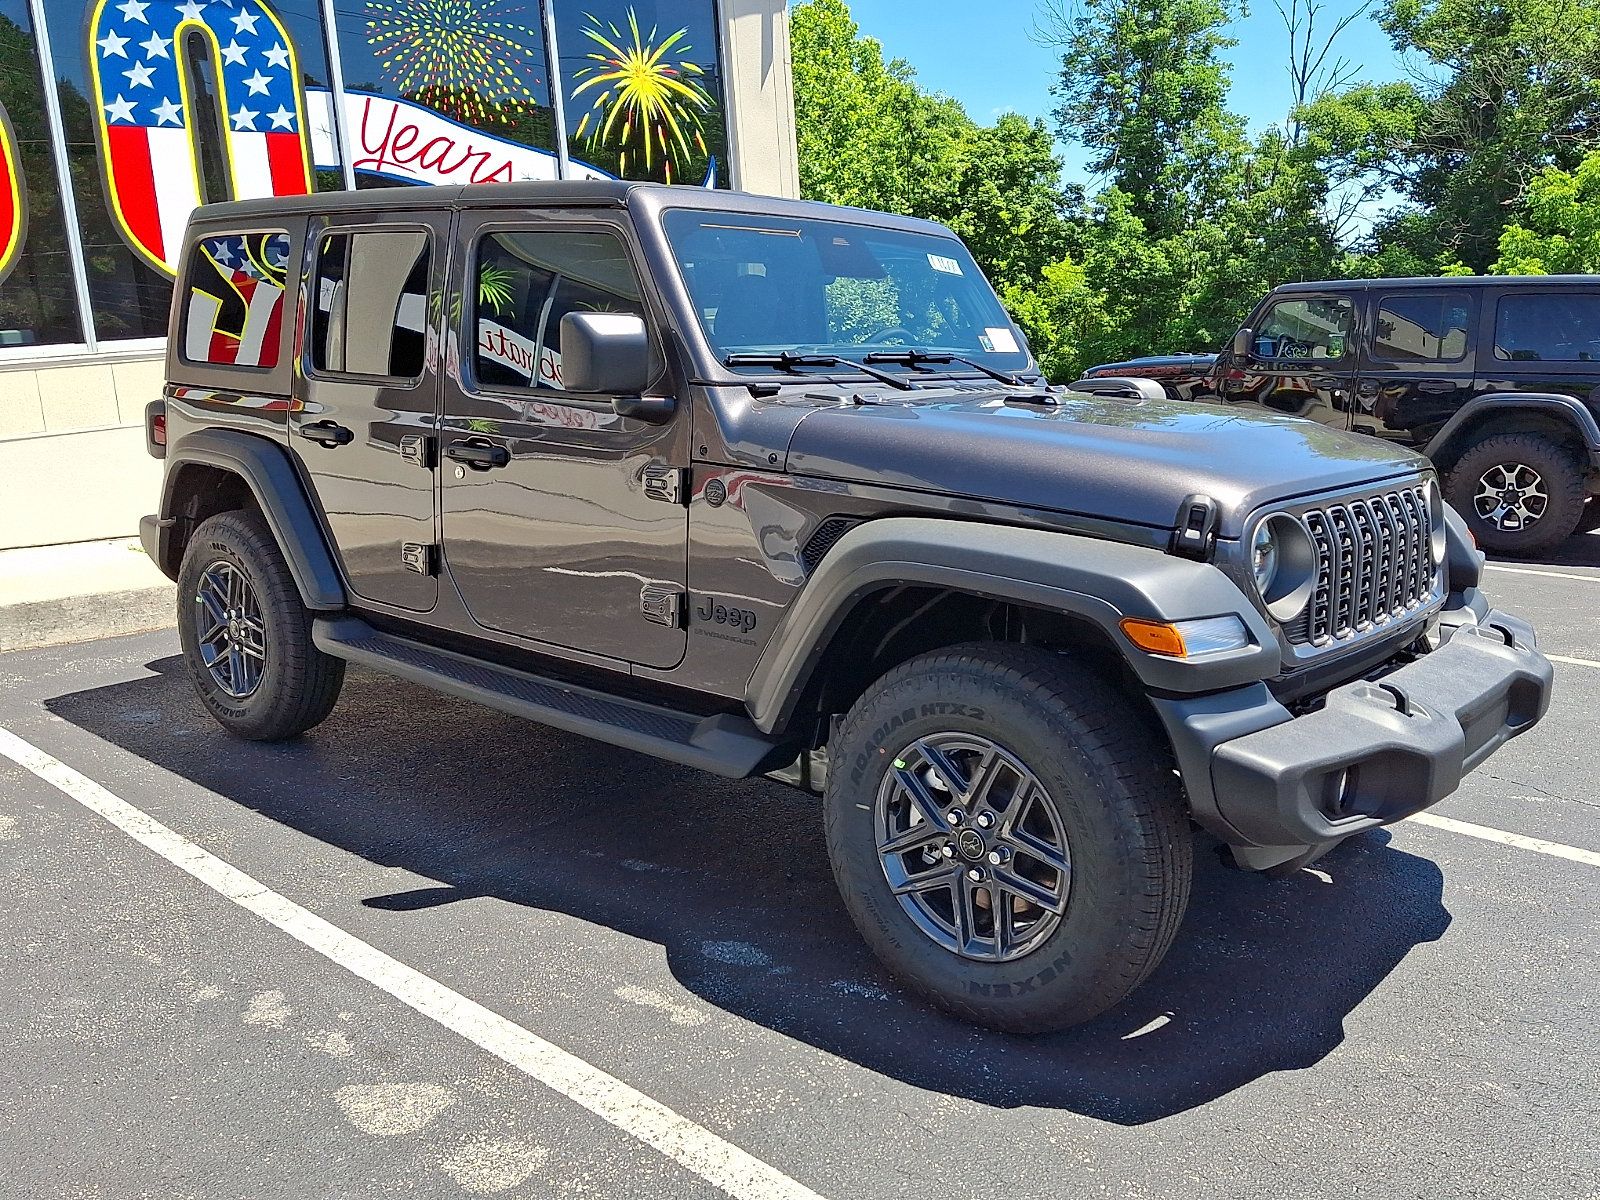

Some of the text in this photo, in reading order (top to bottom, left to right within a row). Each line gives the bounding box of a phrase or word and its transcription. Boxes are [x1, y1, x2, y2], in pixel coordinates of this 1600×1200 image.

[353, 97, 512, 183] Years
[1096, 366, 1182, 377] RUBICON
[696, 597, 757, 633] Jeep
[850, 701, 986, 785] ROADIAN HTX2
[968, 950, 1072, 997] NEXEN
